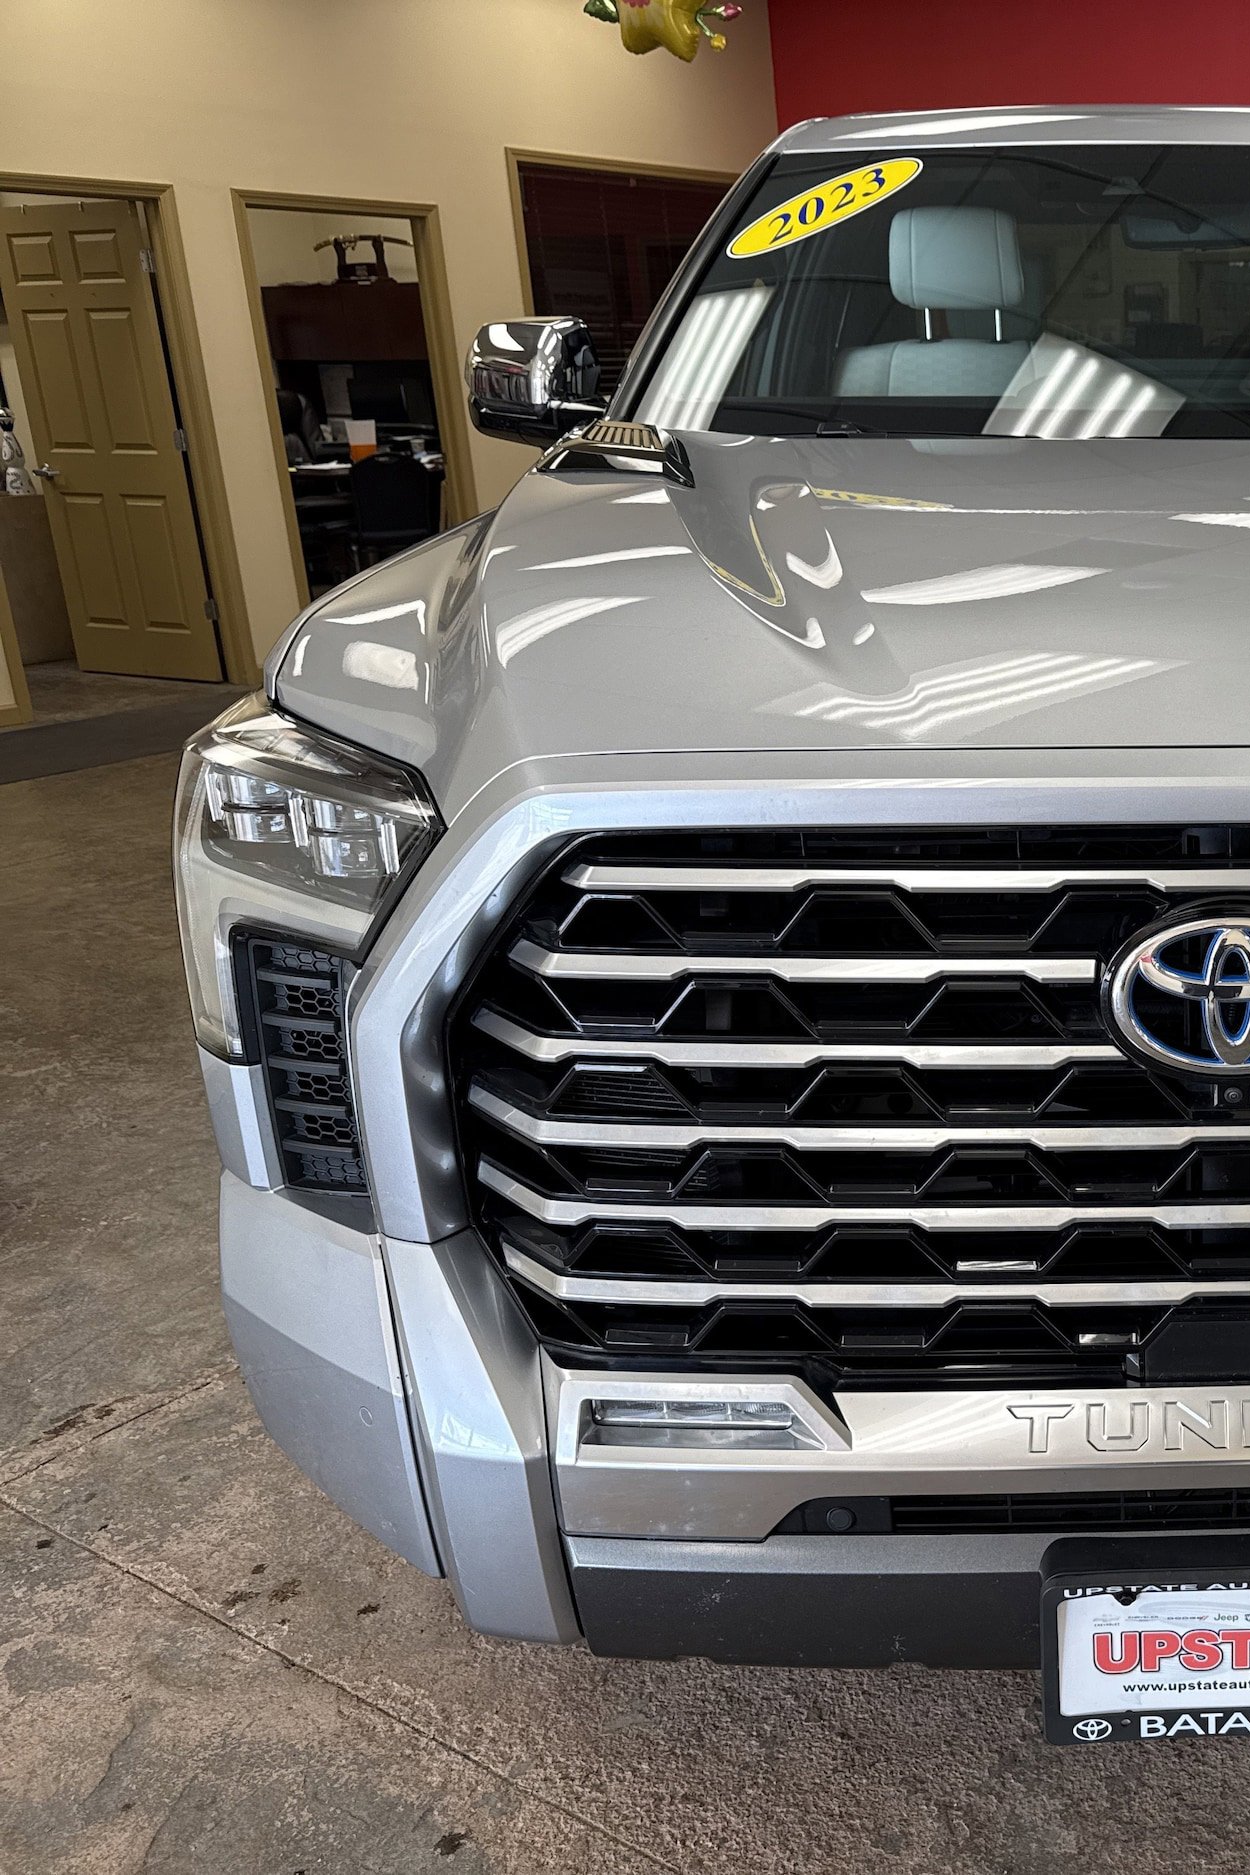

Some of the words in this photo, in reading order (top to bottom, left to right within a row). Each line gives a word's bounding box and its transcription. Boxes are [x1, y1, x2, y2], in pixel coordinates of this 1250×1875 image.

[768, 168, 886, 245] 2023
[1063, 1583, 1198, 1599] UPSTATE
[1213, 1612, 1239, 1622] Jeep
